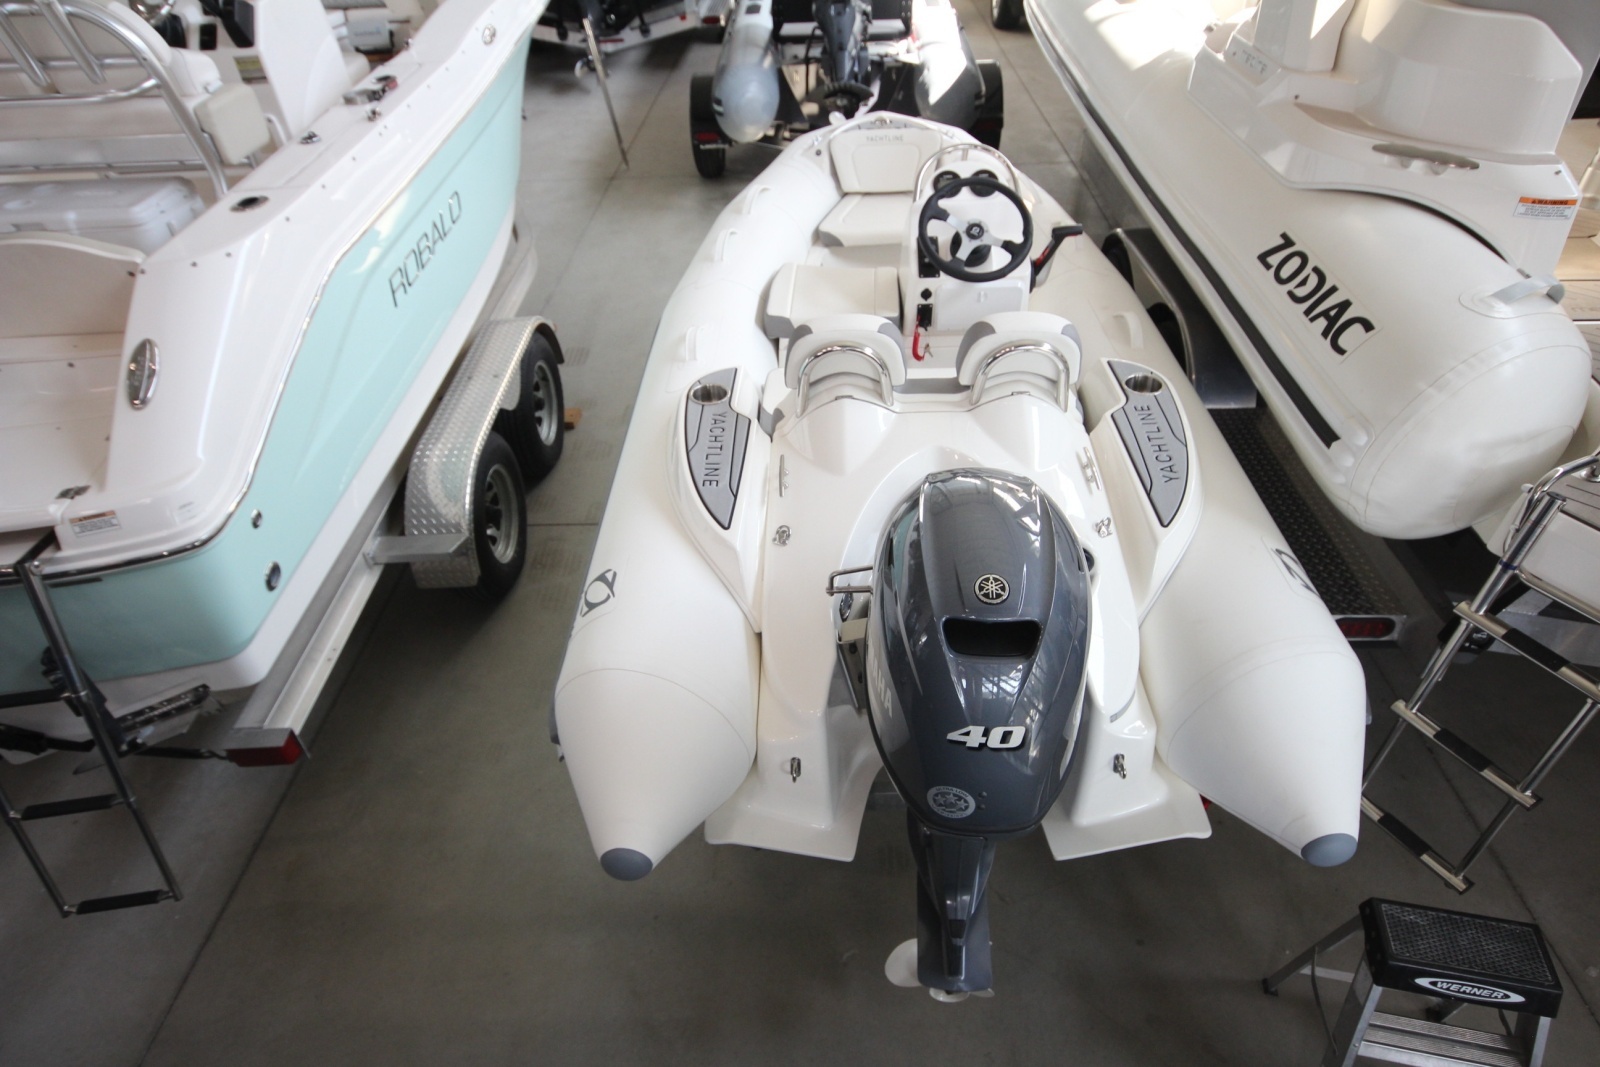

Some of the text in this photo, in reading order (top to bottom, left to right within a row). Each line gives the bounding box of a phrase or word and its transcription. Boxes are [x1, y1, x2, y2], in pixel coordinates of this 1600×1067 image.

[388, 190, 462, 308] ROBALO
[1256, 231, 1376, 356] ZODIAC
[702, 411, 728, 487] YACHTLINE
[1133, 404, 1180, 483] YACHTLINE
[946, 725, 1026, 749] 40
[1436, 981, 1504, 999] WERNER
